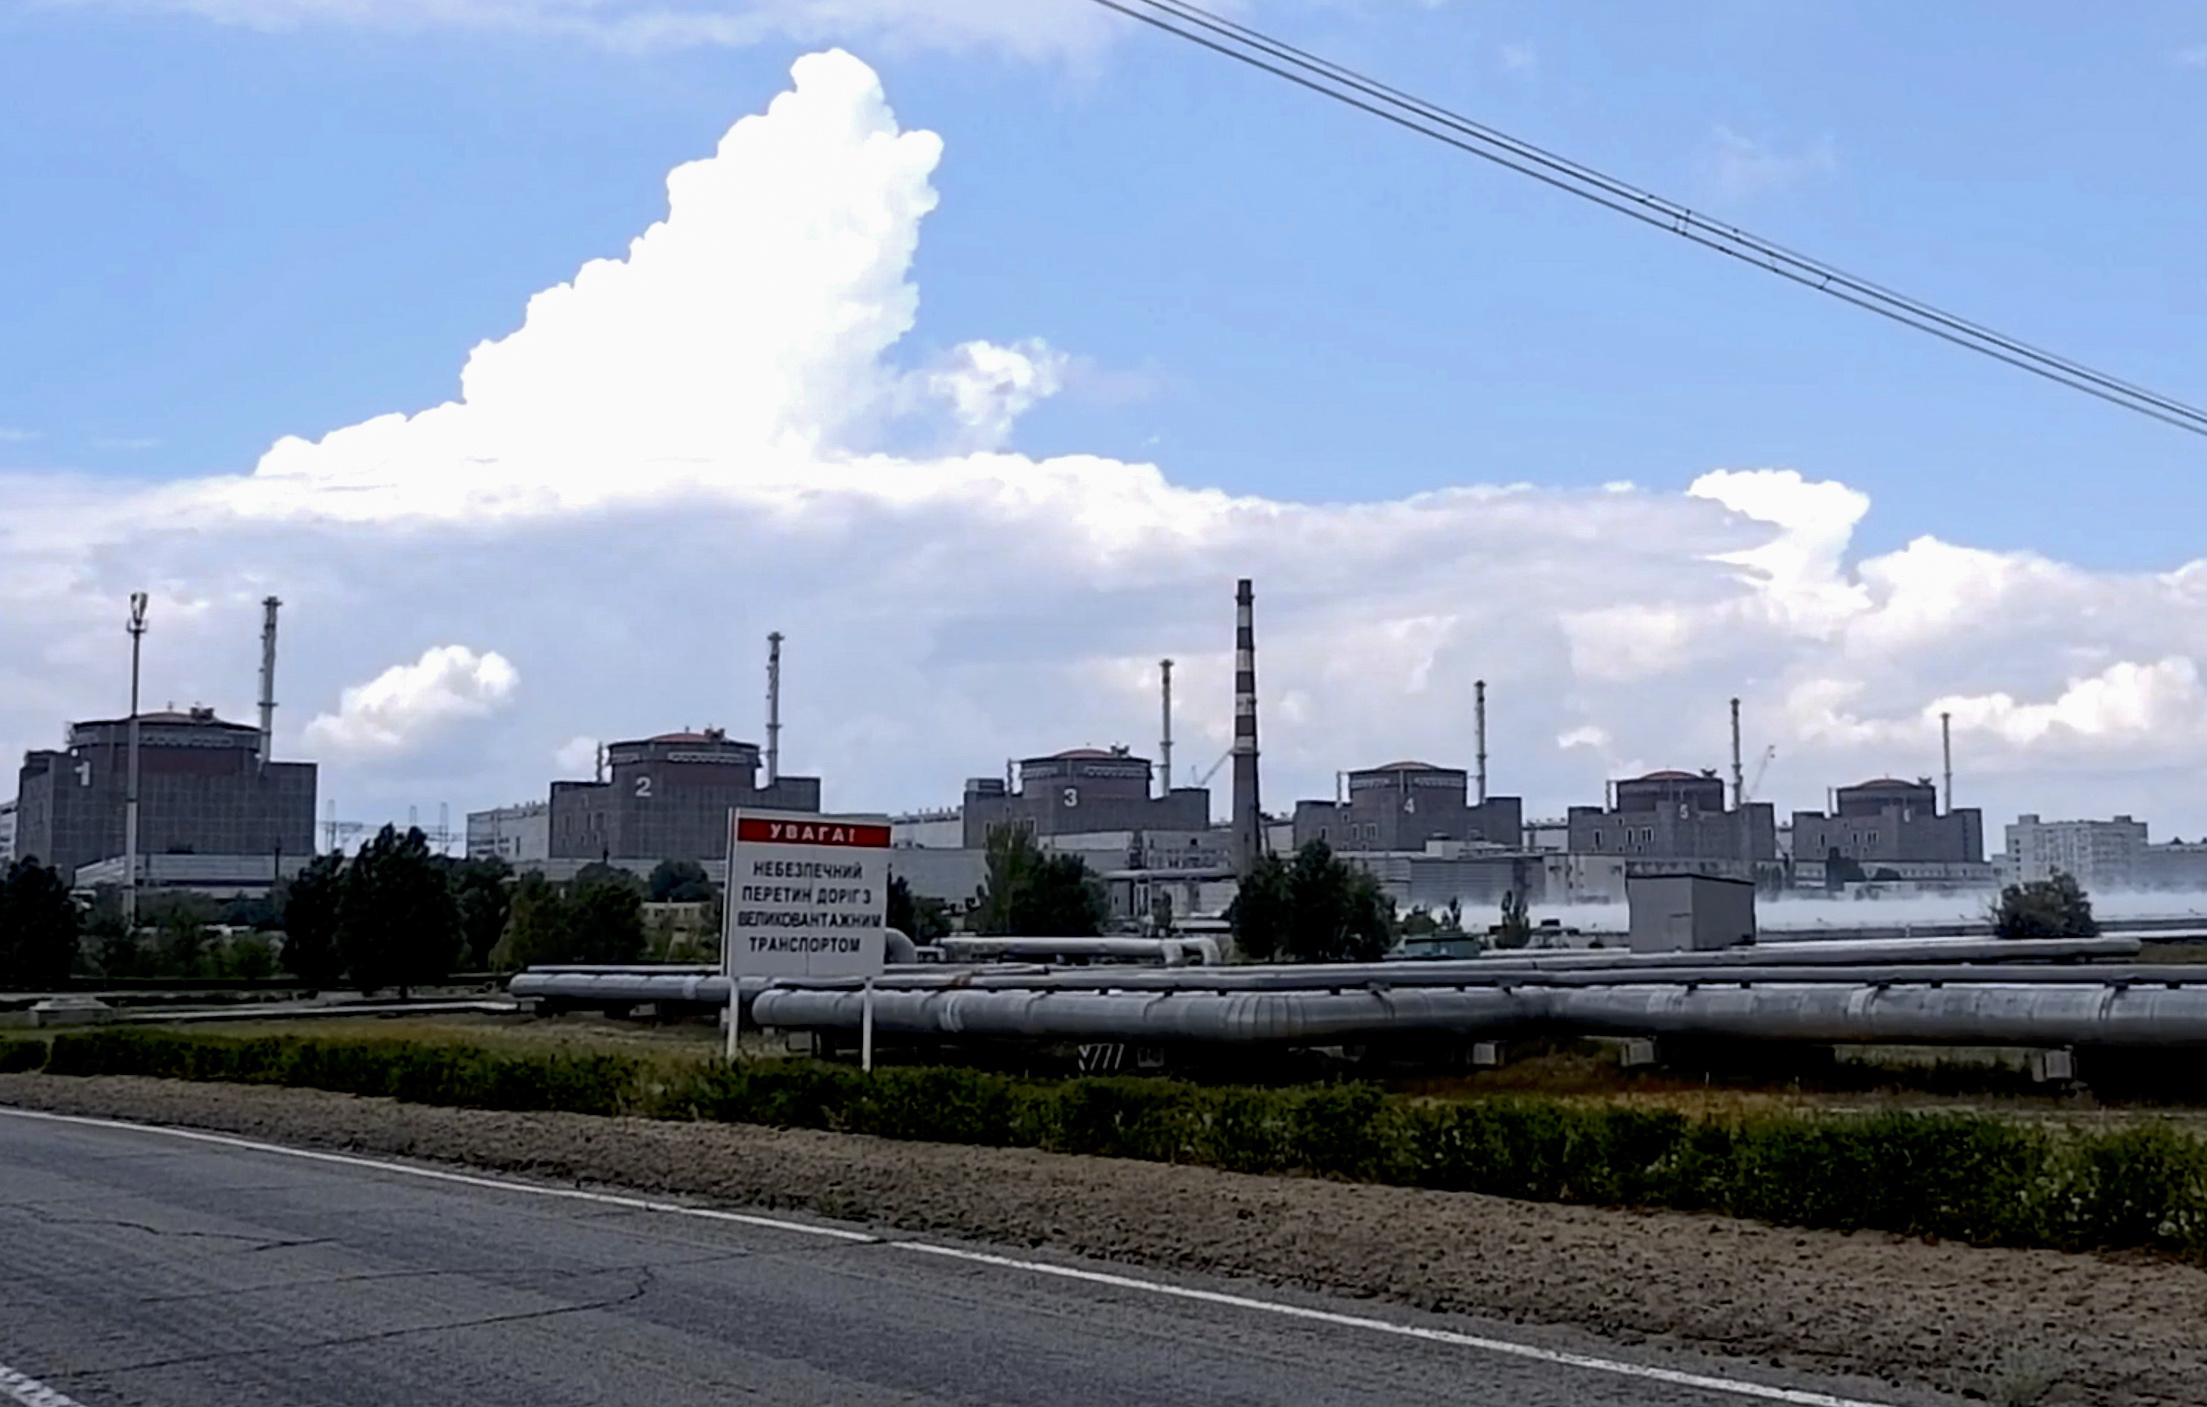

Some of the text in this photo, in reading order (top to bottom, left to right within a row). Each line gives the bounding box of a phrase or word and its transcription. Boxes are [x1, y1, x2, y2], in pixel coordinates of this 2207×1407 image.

[75, 761, 90, 786] 1
[636, 777, 652, 796] 2
[1064, 788, 1077, 806] 3
[1404, 798, 1414, 813] 4
[770, 823, 856, 842] УВАГА!
[753, 861, 863, 879] НЕБЕЗПЕЧНИЙ
[742, 886, 811, 903] ПЕРЕТИН
[816, 889, 860, 905] ДОРІГ
[738, 911, 881, 928] ВЕЛИКОВАНТАЖНИМ
[749, 936, 861, 953] ТРАНСПОРТОМ
